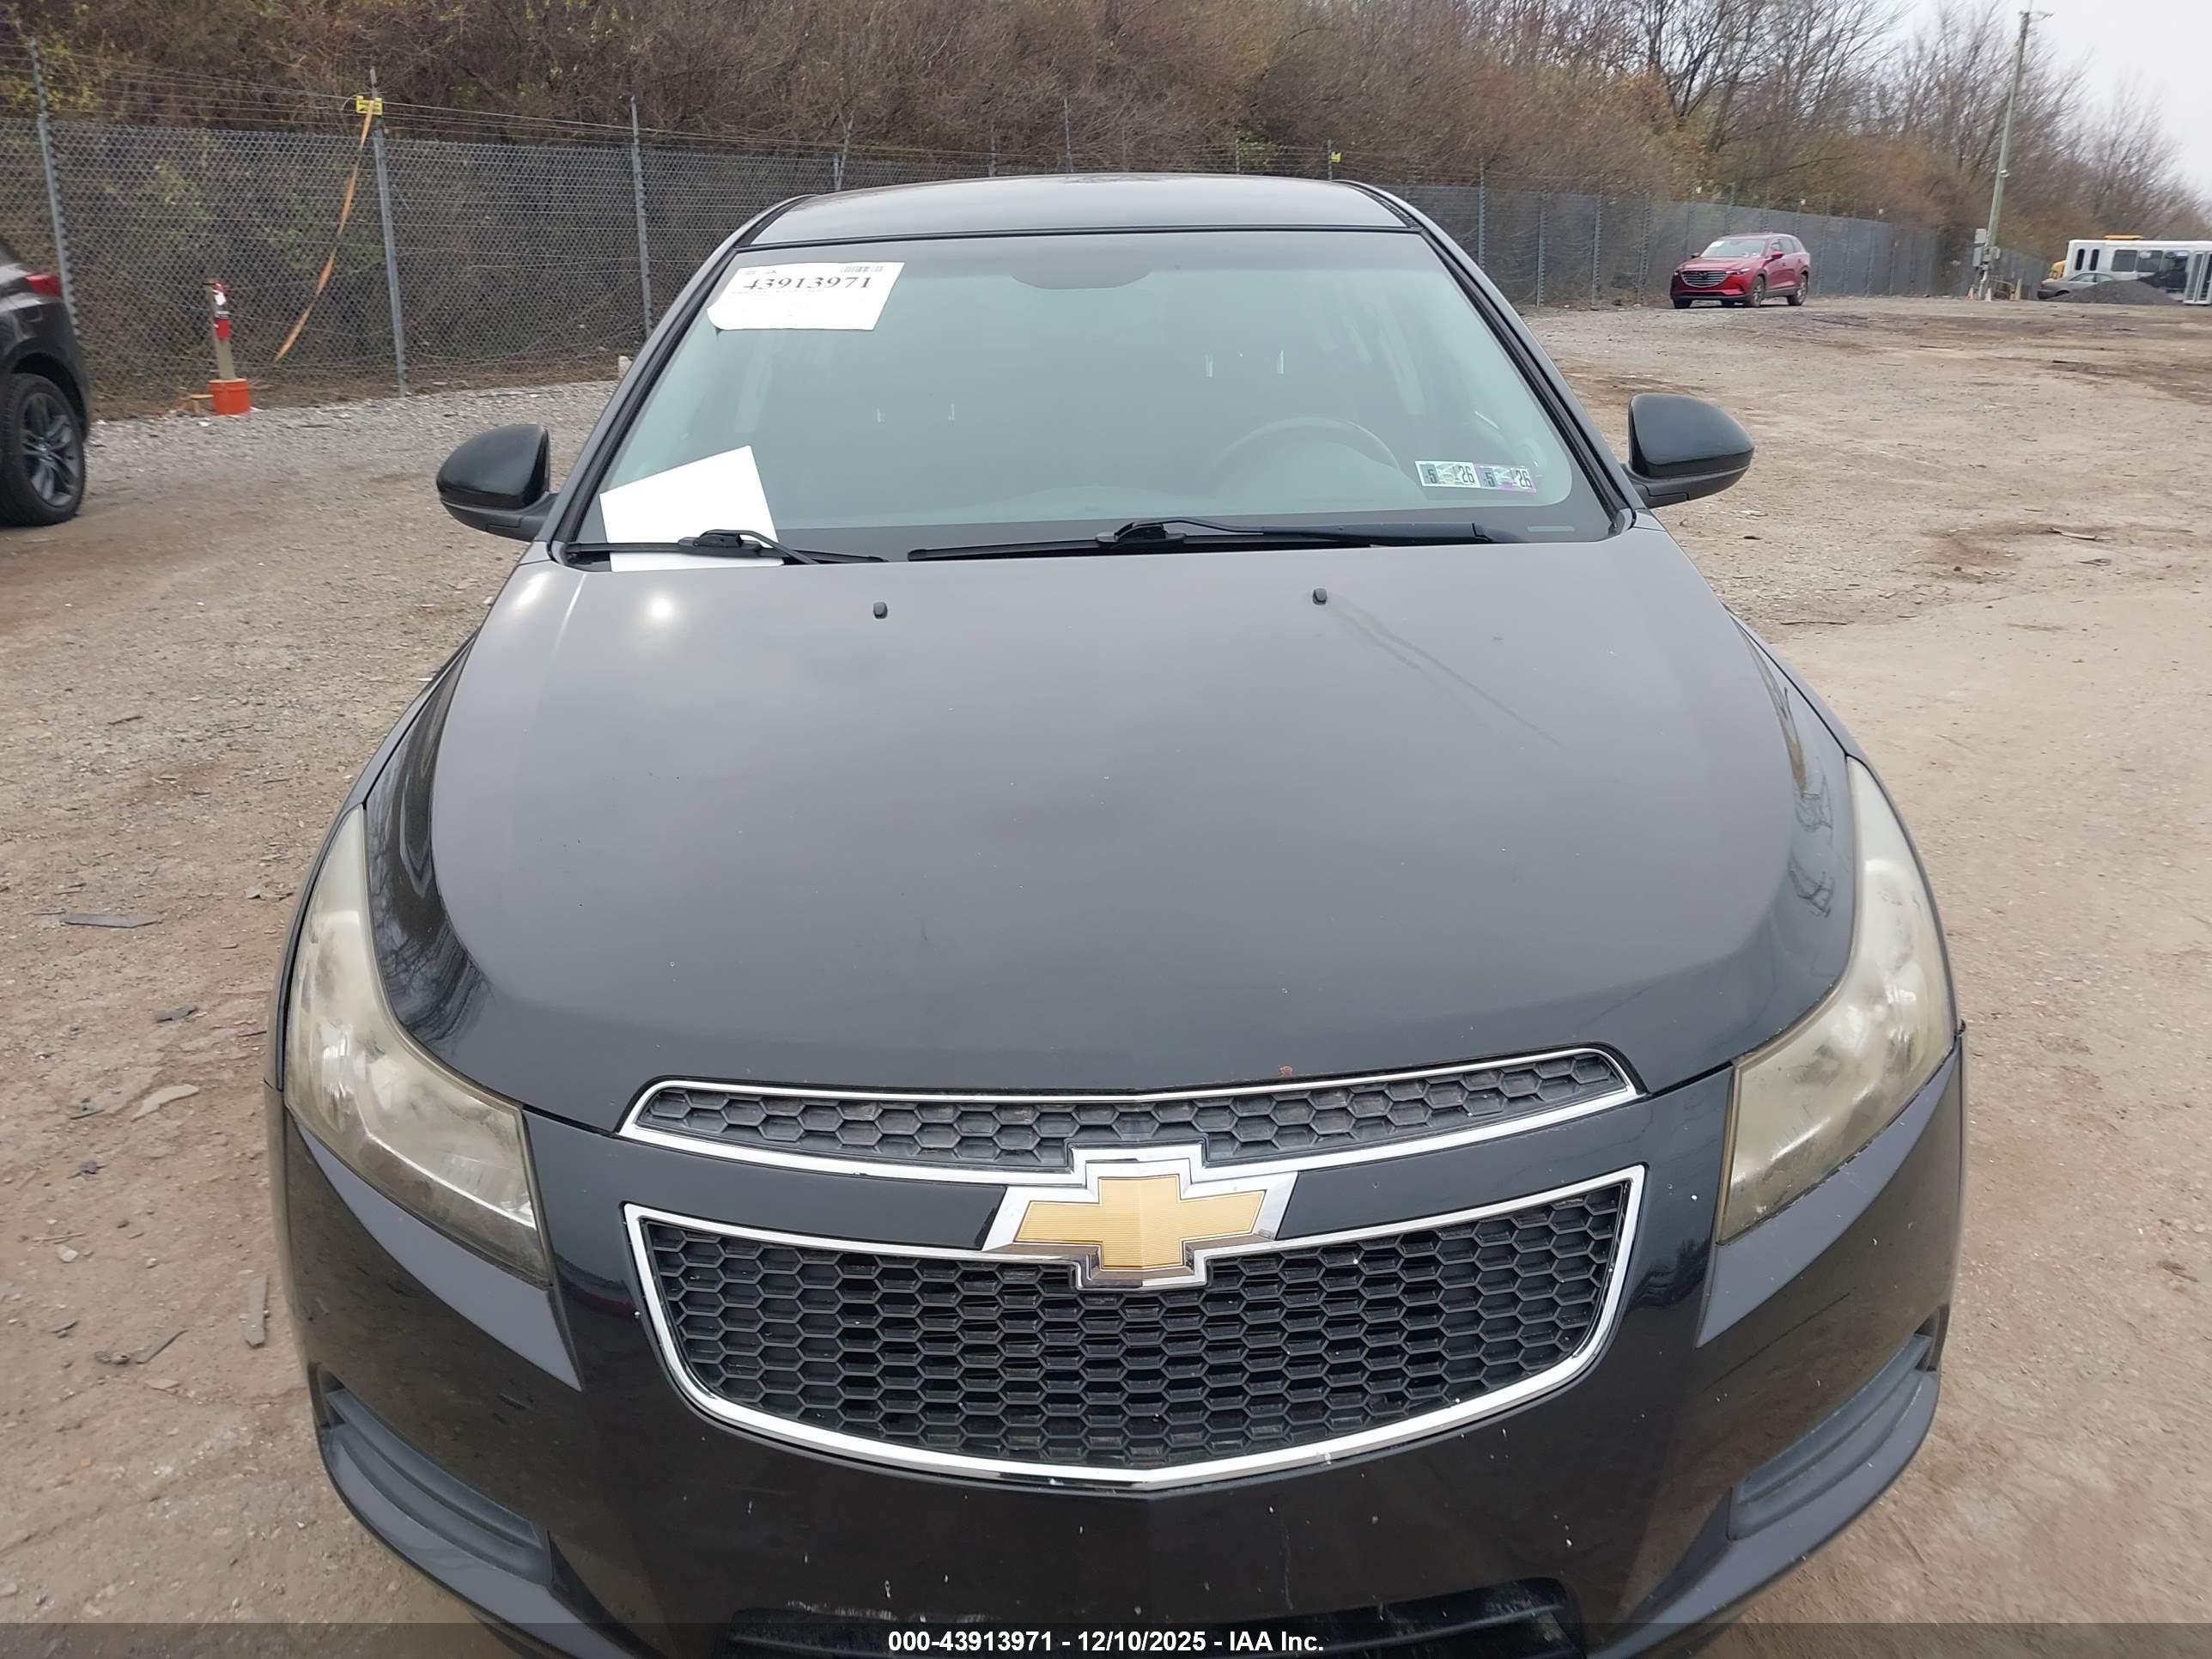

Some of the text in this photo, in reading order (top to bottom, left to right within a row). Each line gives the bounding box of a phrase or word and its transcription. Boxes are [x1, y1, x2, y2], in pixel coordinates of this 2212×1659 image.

[743, 276, 873, 290] 43913971
[1458, 465, 1475, 483] 26
[1516, 470, 1532, 488] 26
